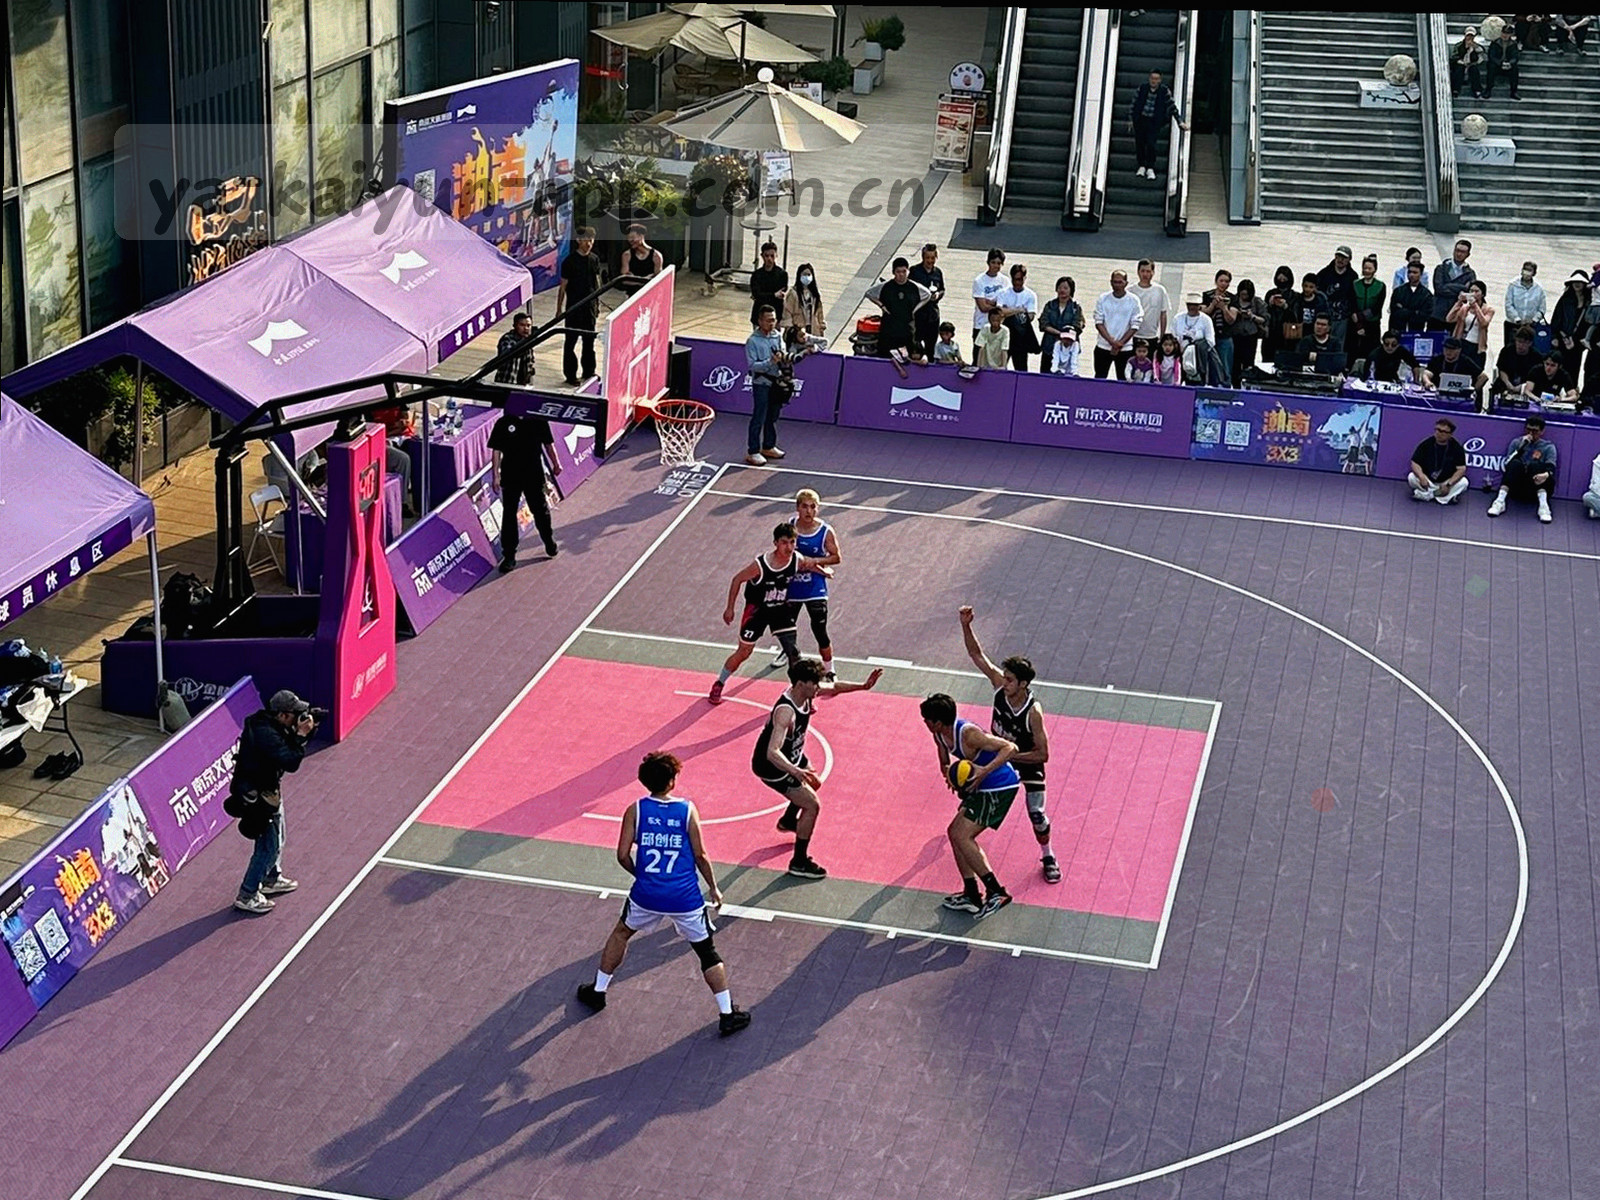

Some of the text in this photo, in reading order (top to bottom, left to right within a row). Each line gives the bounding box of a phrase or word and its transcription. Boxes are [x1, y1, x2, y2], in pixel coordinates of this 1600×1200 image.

[1075, 407, 1163, 426] 南京文旅集团
[1465, 453, 1508, 473] LDIN
[744, 629, 753, 639] 27
[191, 740, 240, 797] 南京文旅
[641, 832, 682, 849] 邱创佳
[645, 849, 679, 873] 27
